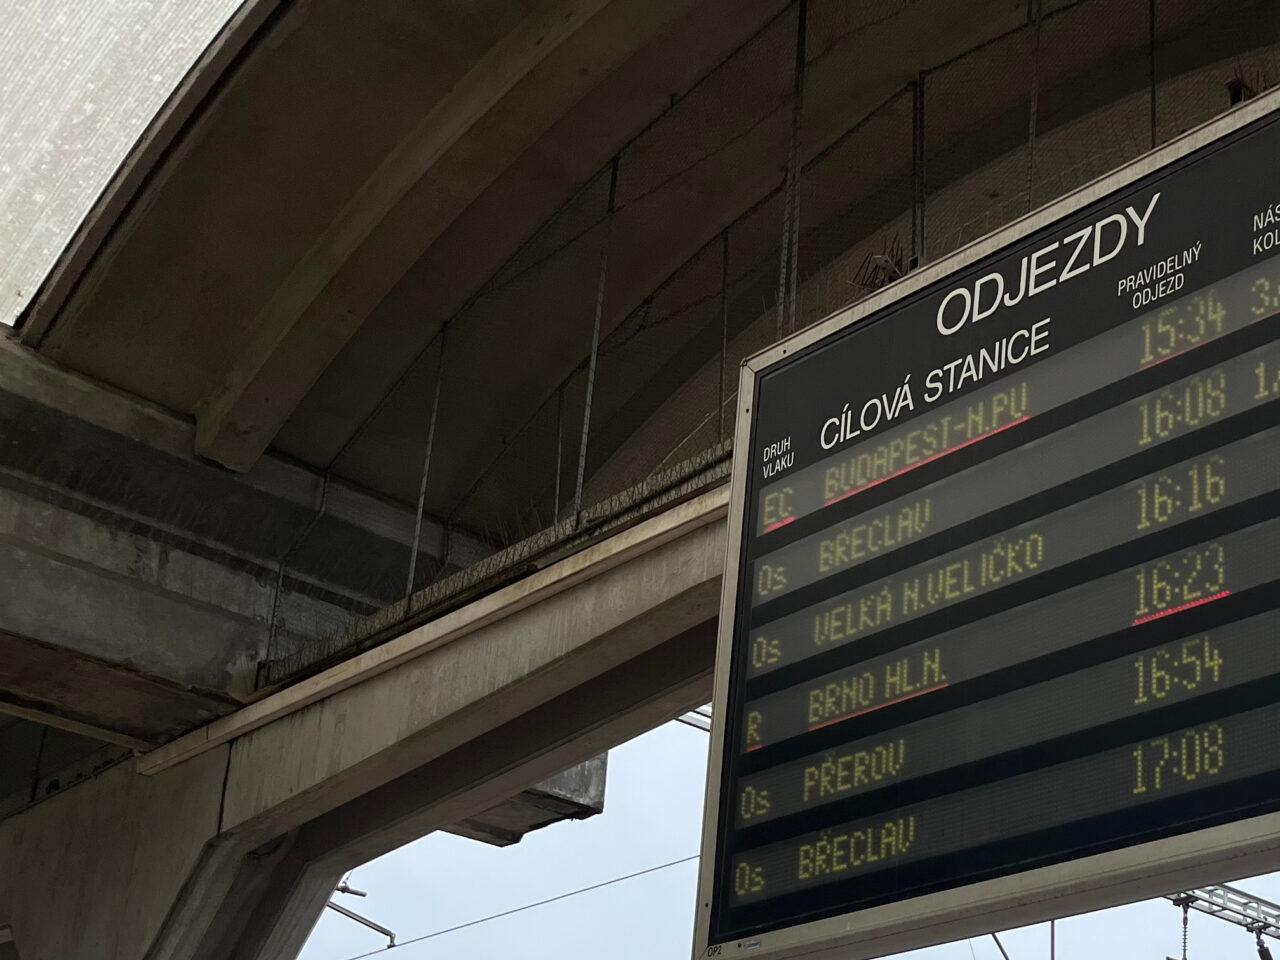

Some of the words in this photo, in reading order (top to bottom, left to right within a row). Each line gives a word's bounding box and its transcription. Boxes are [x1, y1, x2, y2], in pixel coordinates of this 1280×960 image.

[936, 192, 1160, 336] ODJEZDY
[1117, 241, 1203, 297] PRAVIDELNÝ
[1132, 273, 1185, 310] ODJEZD
[820, 374, 915, 450] CÍLOVÁ
[923, 317, 1052, 403] STANICE
[1138, 370, 1226, 446] 16:08
[762, 452, 795, 479] VLAKU
[763, 436, 792, 463] DRUH
[763, 487, 795, 526] EC
[1137, 455, 1225, 530] 16:16
[746, 710, 763, 745] R
[808, 672, 875, 724] BRNO
[1135, 542, 1224, 616] 16:23
[1134, 636, 1223, 705] 16:54
[1132, 724, 1223, 794] 17:08
